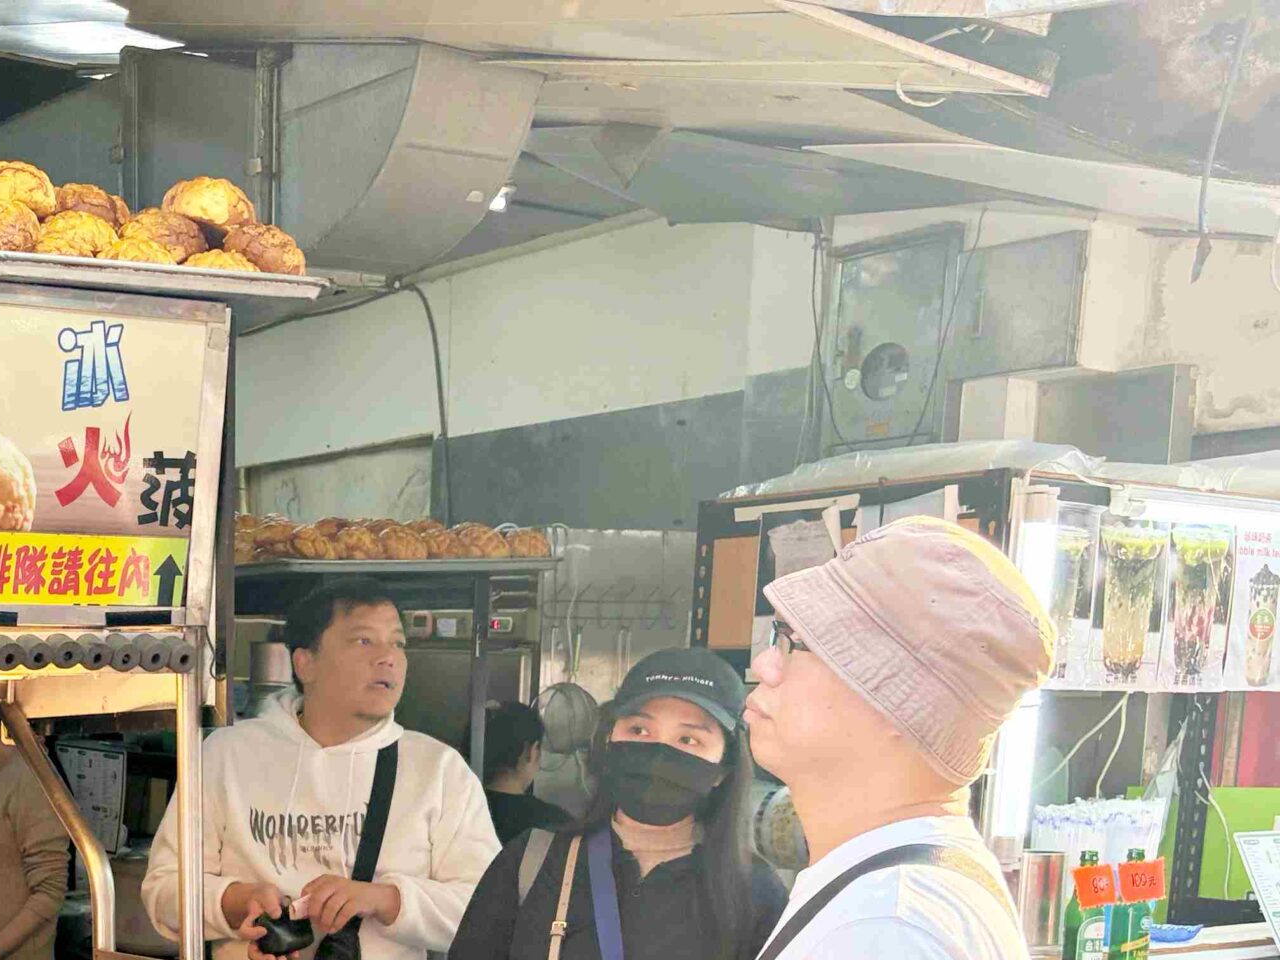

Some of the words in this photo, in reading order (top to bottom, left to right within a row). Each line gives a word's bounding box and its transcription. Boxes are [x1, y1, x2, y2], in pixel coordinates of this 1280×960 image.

[55, 320, 133, 508] 冰火
[646, 674, 674, 682] TOMMY
[249, 804, 368, 847] WONDERFU
